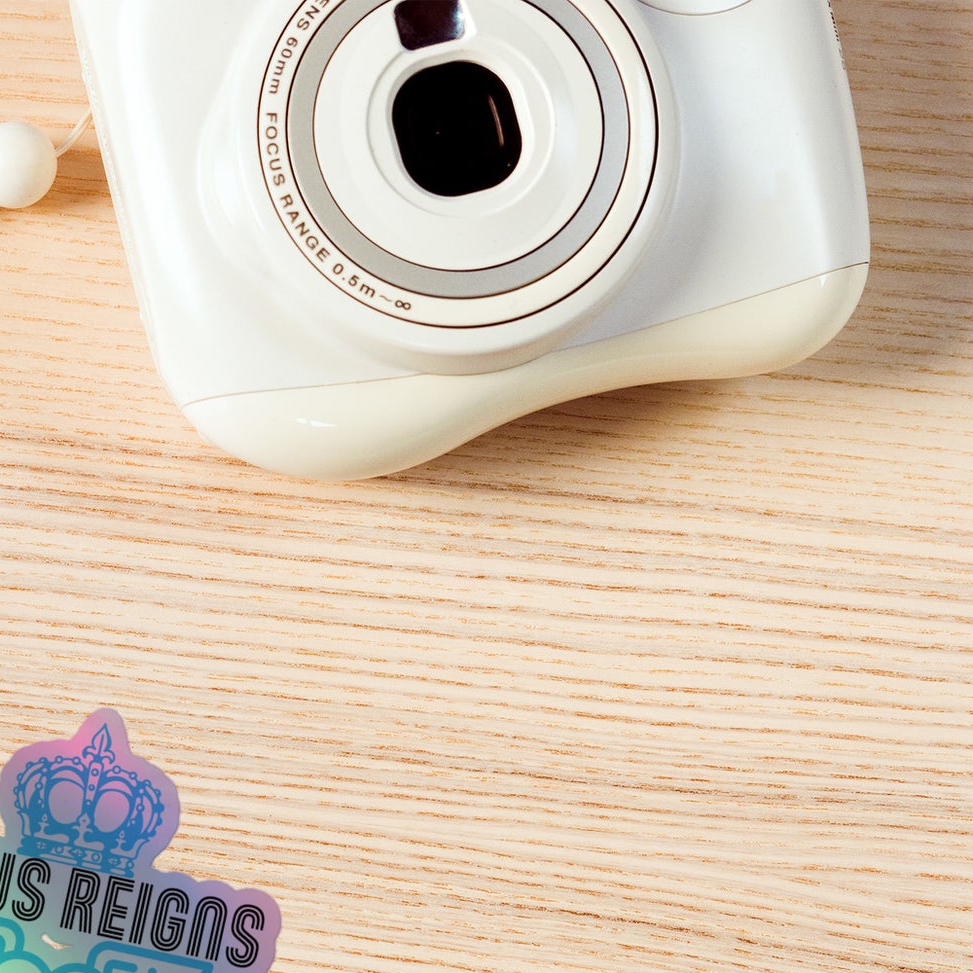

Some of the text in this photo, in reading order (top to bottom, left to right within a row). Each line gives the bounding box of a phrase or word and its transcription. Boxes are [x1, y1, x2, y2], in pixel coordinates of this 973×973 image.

[268, 37, 298, 95] 60mm
[265, 112, 286, 187] FOCUS
[280, 193, 330, 262] RANGE
[60, 868, 265, 968] REIGNS
